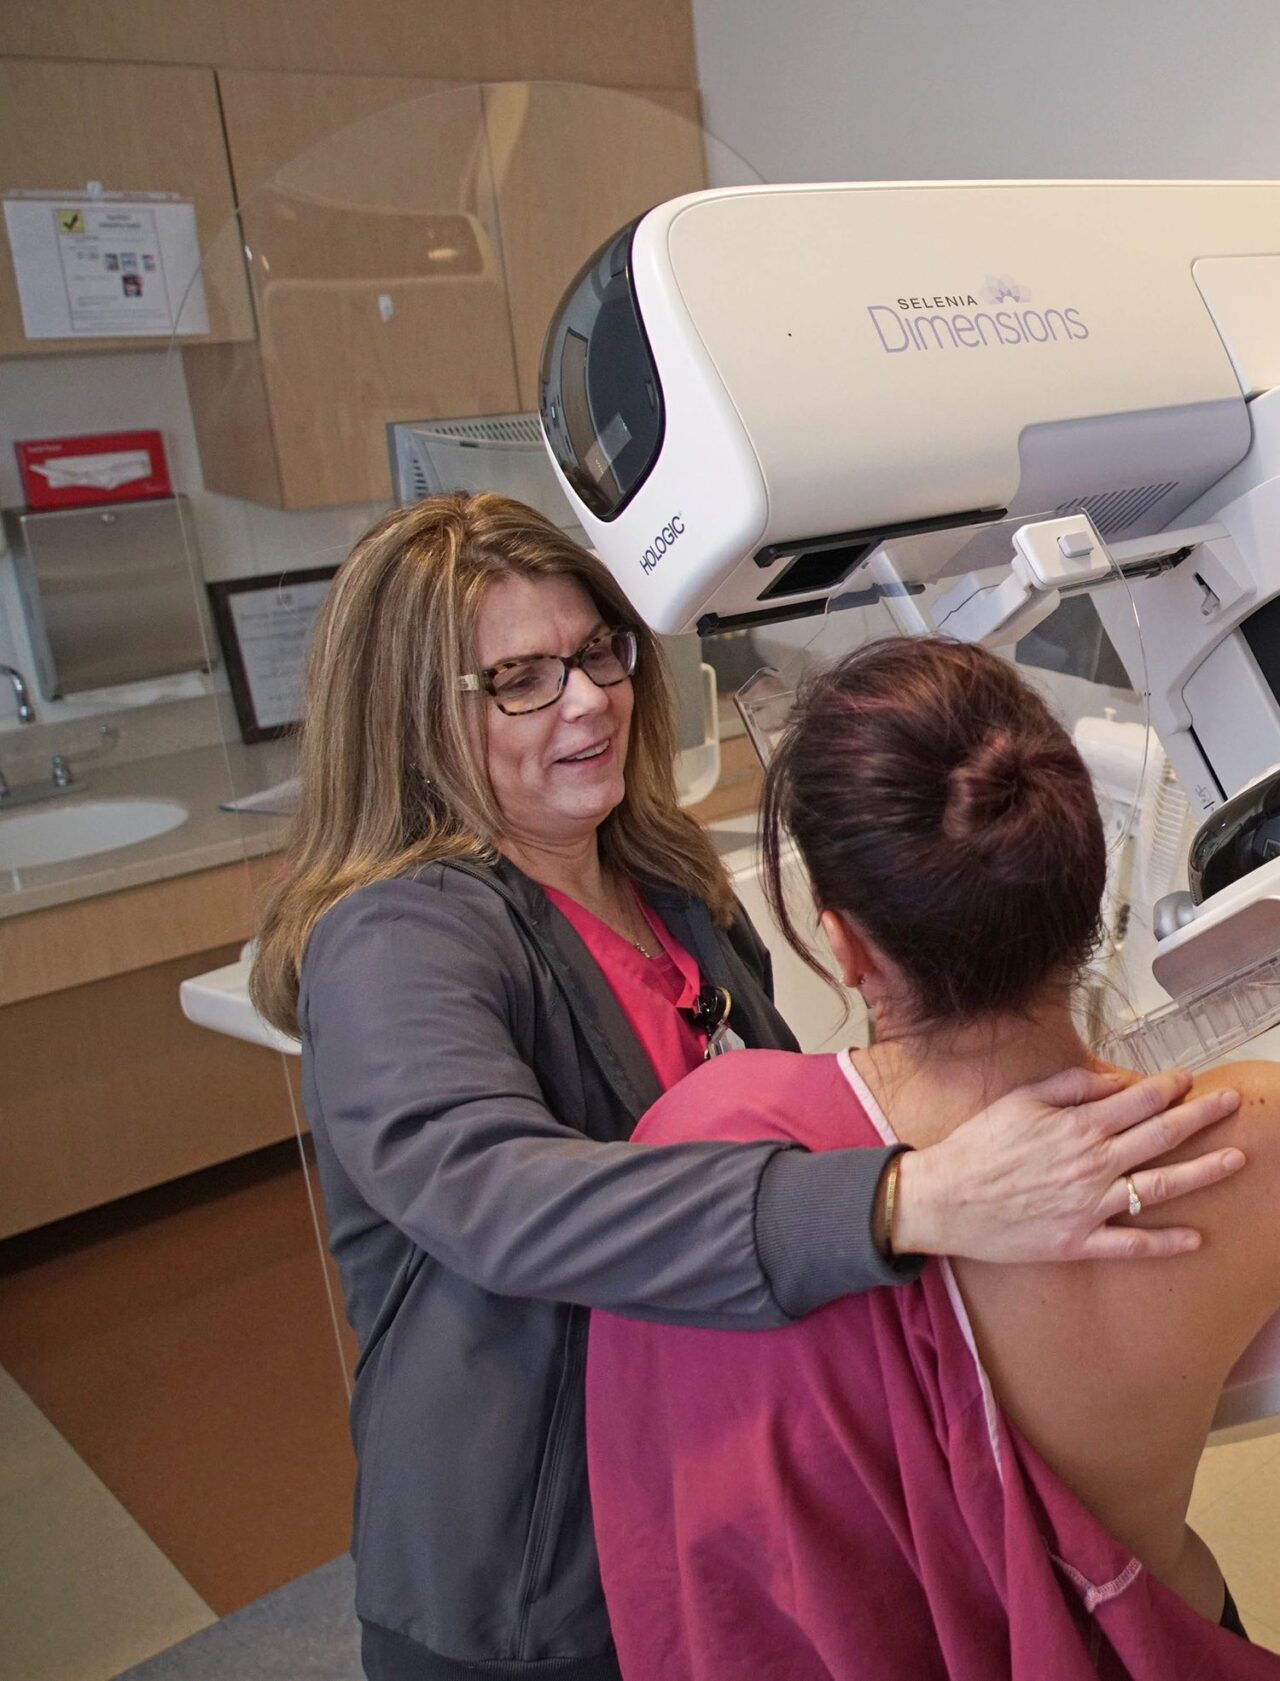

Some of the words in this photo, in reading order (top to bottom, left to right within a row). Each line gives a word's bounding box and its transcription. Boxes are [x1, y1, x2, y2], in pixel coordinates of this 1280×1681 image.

[897, 294, 979, 311] SELENIA
[866, 304, 1090, 354] Dimensions
[639, 515, 685, 577] HOLOGIC
